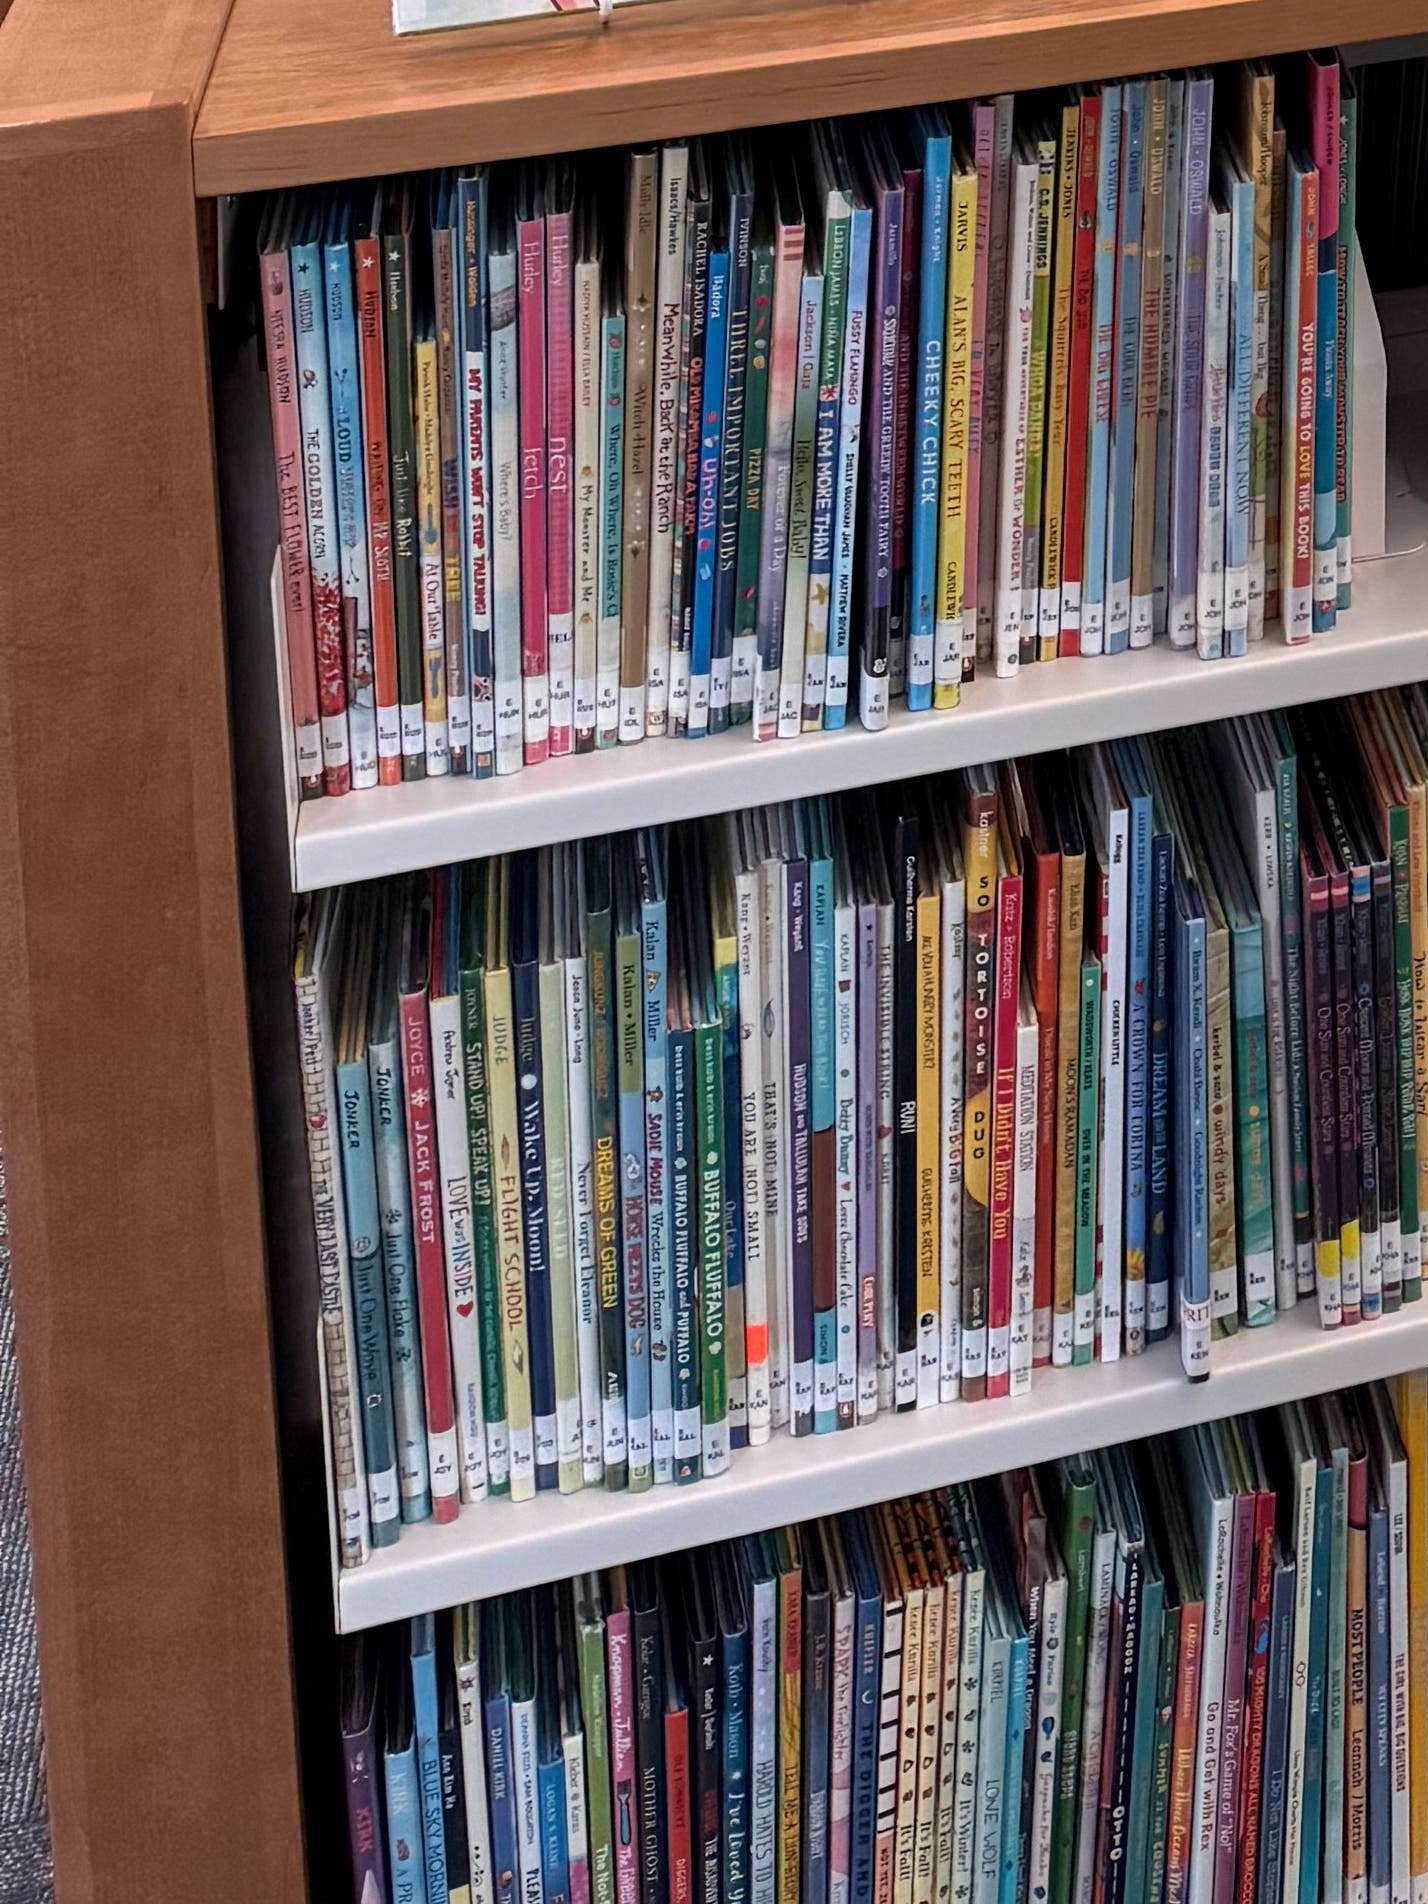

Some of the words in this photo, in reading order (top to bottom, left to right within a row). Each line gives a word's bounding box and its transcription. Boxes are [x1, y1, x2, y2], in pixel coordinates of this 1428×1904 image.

[955, 200, 969, 254] JARVIS
[522, 241, 541, 293] Hurley
[552, 234, 570, 289] Hurley
[731, 309, 748, 370] THREE
[923, 340, 941, 422] CHEEKY
[549, 436, 570, 494] nest
[723, 379, 745, 504] IMPORTANT
[919, 432, 937, 504] CHICK
[720, 507, 735, 572] JOBS
[645, 920, 659, 962] Kalan
[647, 1000, 659, 1043] Miller
[975, 932, 991, 1076] TORTOISE
[408, 1015, 426, 1077] JOYCE
[414, 1119, 432, 1175] JACK
[972, 1109, 986, 1160] DUG
[447, 1174, 469, 1221] LOVE
[595, 1135, 614, 1212] DREAMS
[417, 1181, 436, 1245] FROST
[499, 1175, 518, 1246] FLIGHT
[598, 1214, 617, 1242] OF
[701, 1168, 722, 1245] BUFFALO
[451, 1242, 474, 1300] INSIDE
[503, 1251, 524, 1332] SCHOOL
[600, 1244, 619, 1311] GREEN
[702, 1247, 723, 1338] FLUFFALO
[1351, 1608, 1364, 1647] MOST
[1350, 1647, 1363, 1707] PEOPLE
[421, 1758, 439, 1802] BLUE
[984, 1779, 1000, 1826] LONE
[424, 1803, 443, 1844] SKY
[981, 1832, 998, 1881] WOLF
